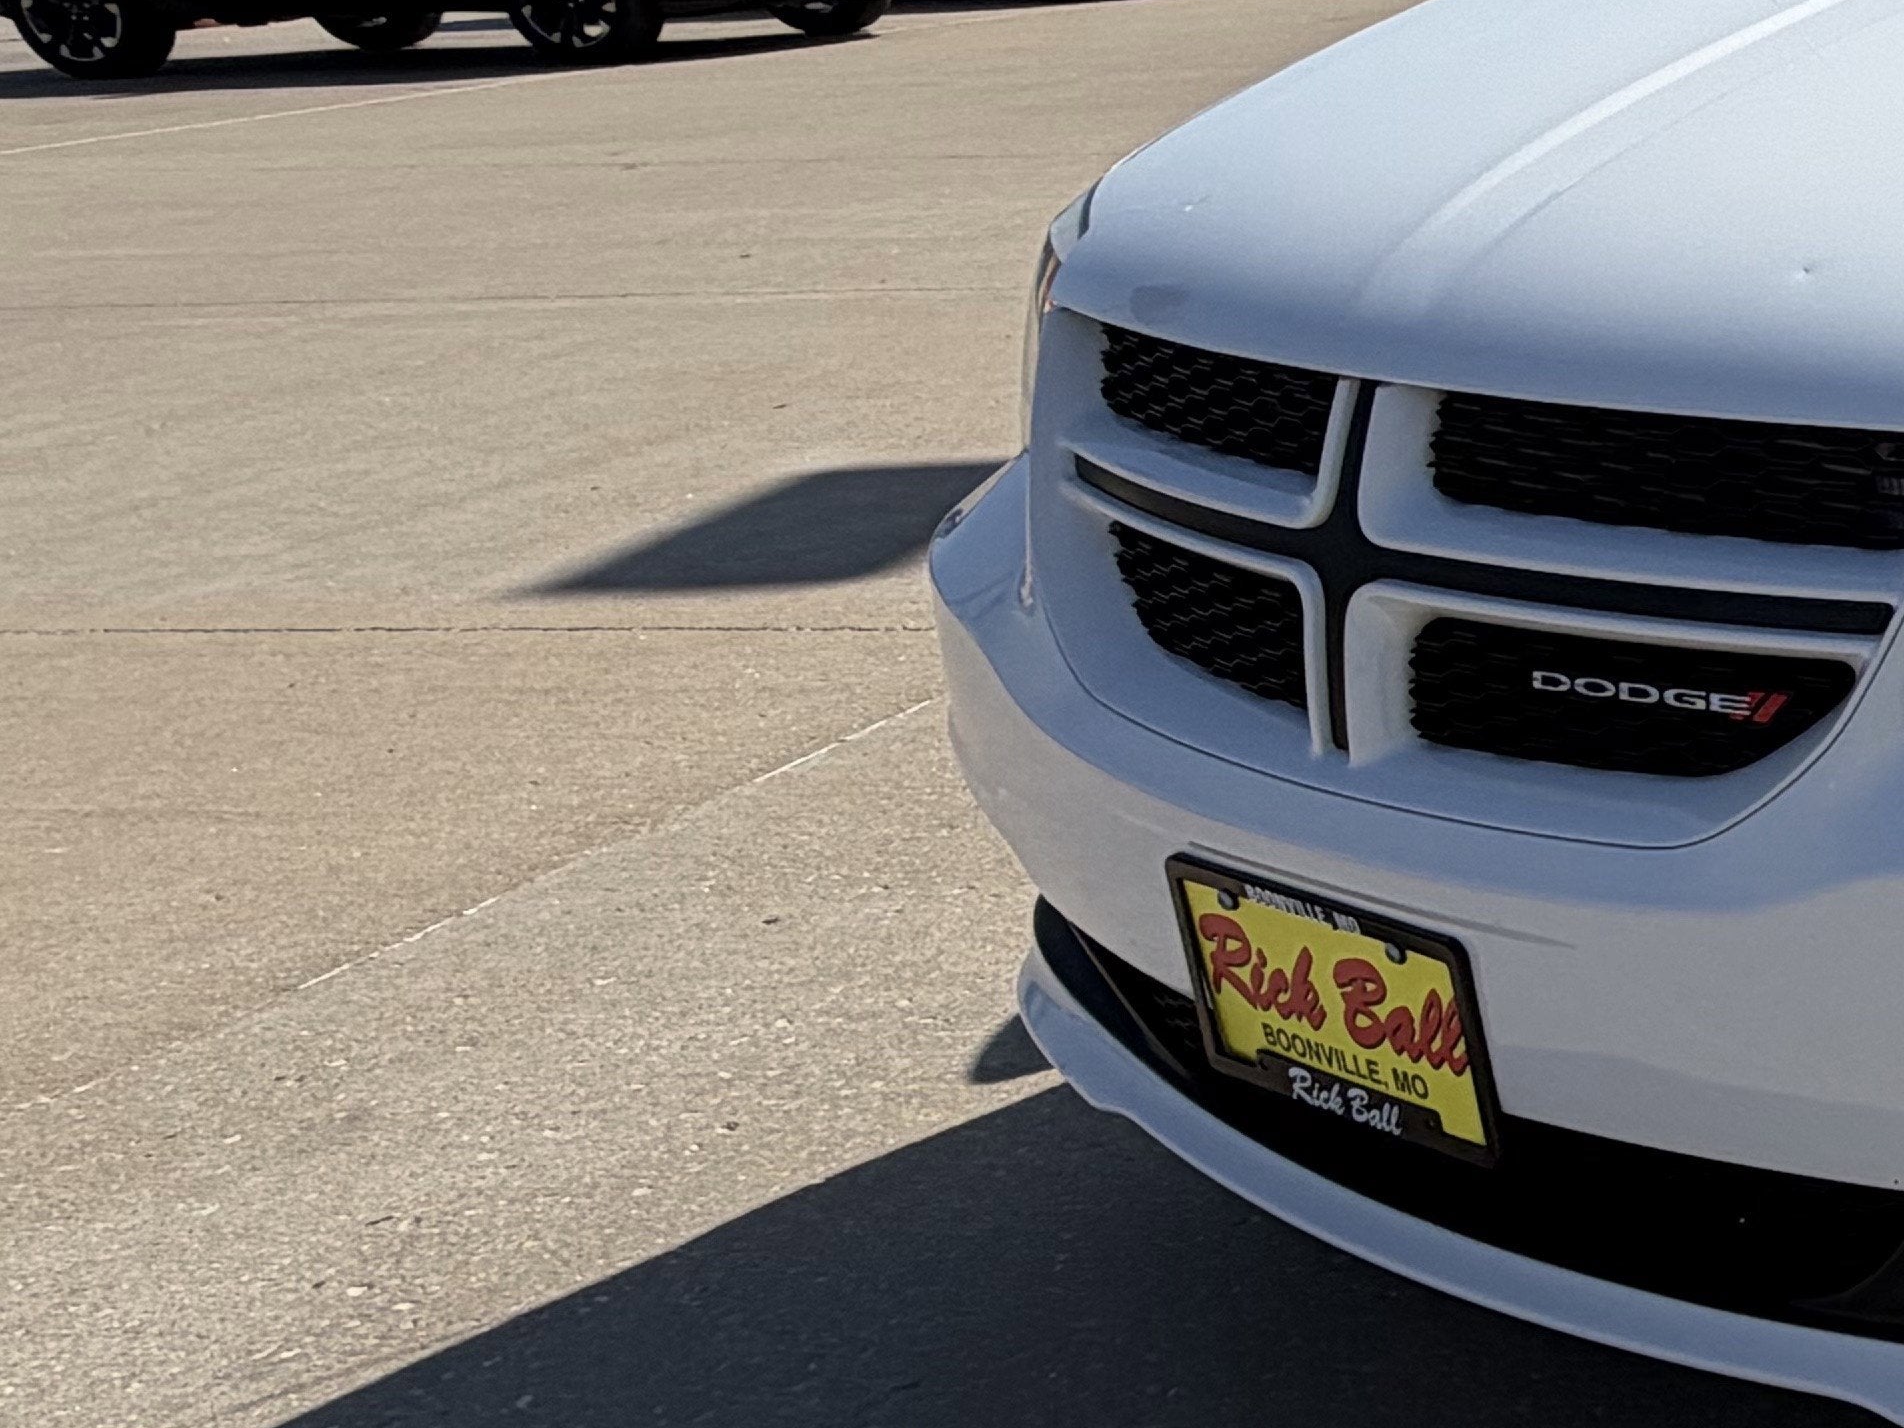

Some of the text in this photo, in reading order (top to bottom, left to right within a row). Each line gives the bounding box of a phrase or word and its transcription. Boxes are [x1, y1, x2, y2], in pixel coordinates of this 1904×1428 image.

[1532, 670, 1752, 716] DODGE
[1198, 913, 1471, 1077] Rick Ball
[1260, 1022, 1430, 1101] BOONVILLE, MO
[1287, 1066, 1402, 1136] Rick Ball
